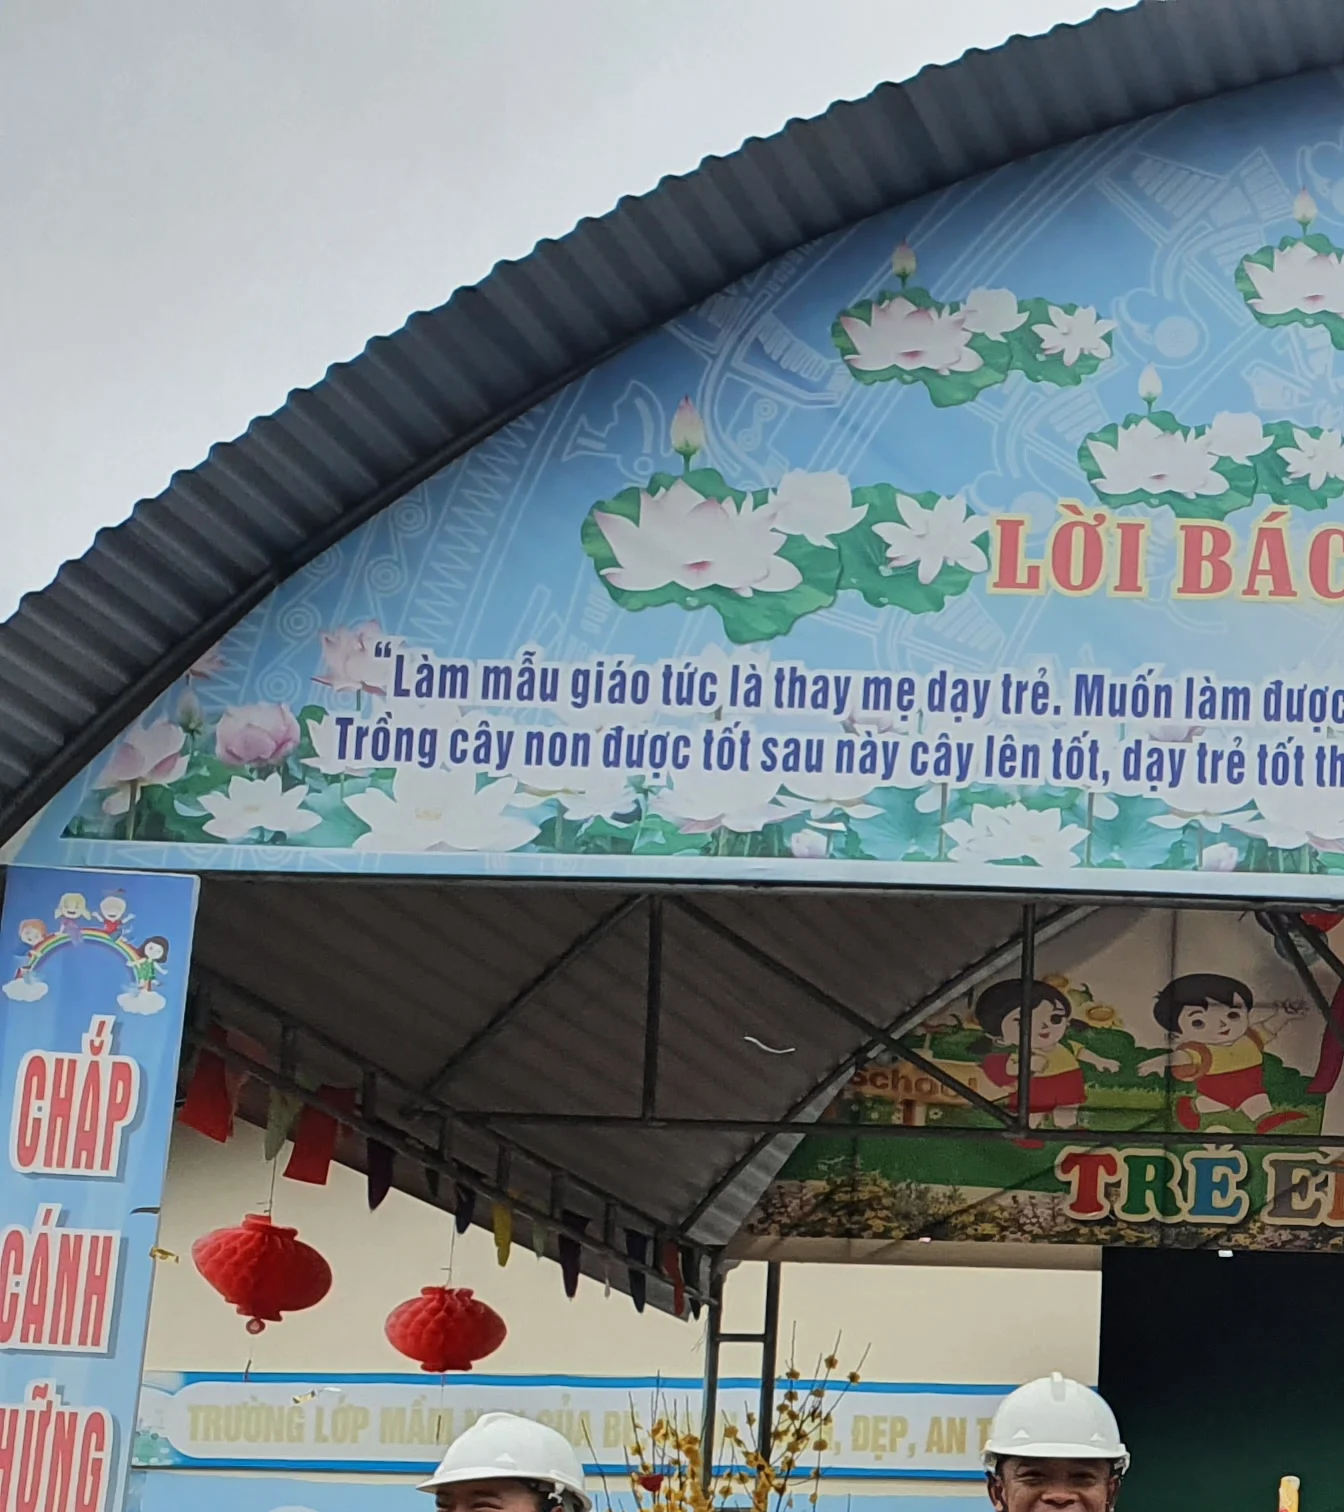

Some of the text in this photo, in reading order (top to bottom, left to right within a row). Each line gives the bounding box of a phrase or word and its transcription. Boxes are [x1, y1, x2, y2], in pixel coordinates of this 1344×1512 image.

[995, 504, 1141, 592] LỜI
[481, 650, 560, 702] mẫu
[571, 660, 650, 709] giáo
[662, 661, 718, 707] tức
[729, 663, 762, 708] là
[774, 666, 852, 716] thay
[862, 676, 916, 722] mẹ
[927, 670, 991, 723] dạy
[1001, 667, 1061, 716] trẻ.
[1074, 668, 1173, 719] Muốn
[1184, 676, 1251, 721] làm
[335, 716, 437, 769] Trồng
[449, 721, 515, 771] cây
[524, 731, 591, 767] non
[602, 725, 691, 779] được
[703, 721, 751, 772] tốt
[760, 737, 824, 773] sau
[835, 730, 900, 781] này
[910, 732, 974, 783] cây
[984, 734, 1040, 779] lên
[1052, 731, 1110, 785] tốt,
[1122, 739, 1186, 792] dạy
[1196, 736, 1246, 785] trẻ
[1257, 736, 1305, 787] tốt
[14, 1021, 133, 1170] CHẮP
[187, 1395, 305, 1444] TRƯỜNG
[314, 1398, 371, 1444] LỚP
[851, 1415, 915, 1459] ĐẸP,
[925, 1416, 969, 1455] AN
